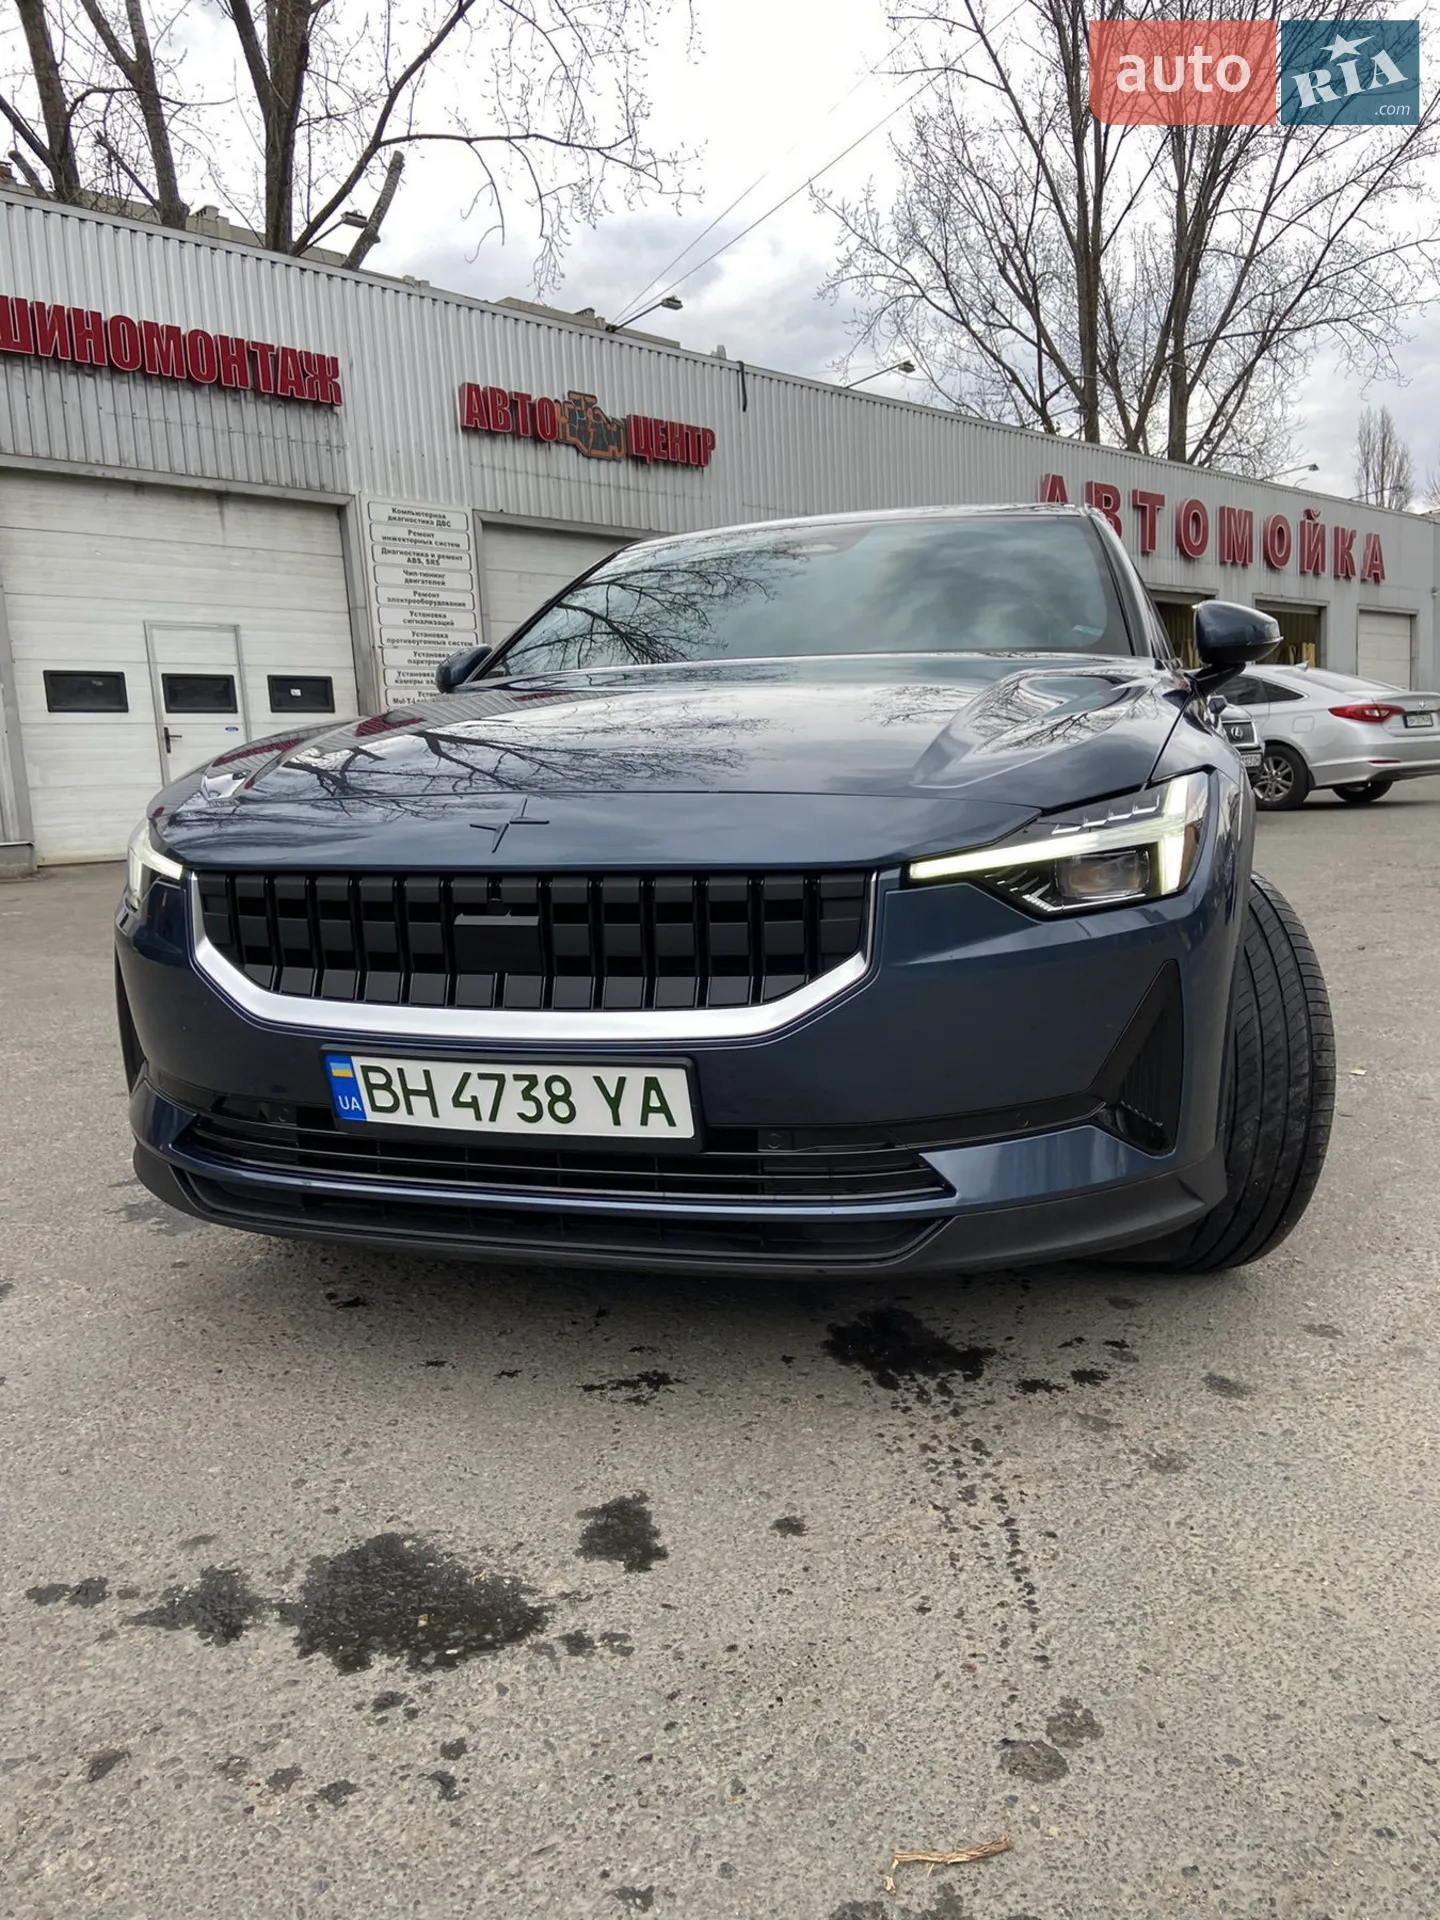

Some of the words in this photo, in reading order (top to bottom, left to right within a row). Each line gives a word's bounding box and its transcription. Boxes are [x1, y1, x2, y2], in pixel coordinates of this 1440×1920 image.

[408, 529, 435, 538] Ремонт
[434, 540, 460, 548] систем
[413, 590, 440, 598] Ремонт
[409, 610, 447, 618] Установка
[396, 670, 435, 678] Установка
[360, 1064, 440, 1118] BH
[452, 1072, 577, 1124] 4738
[592, 1076, 676, 1127] YA
[338, 1095, 362, 1111] UA
